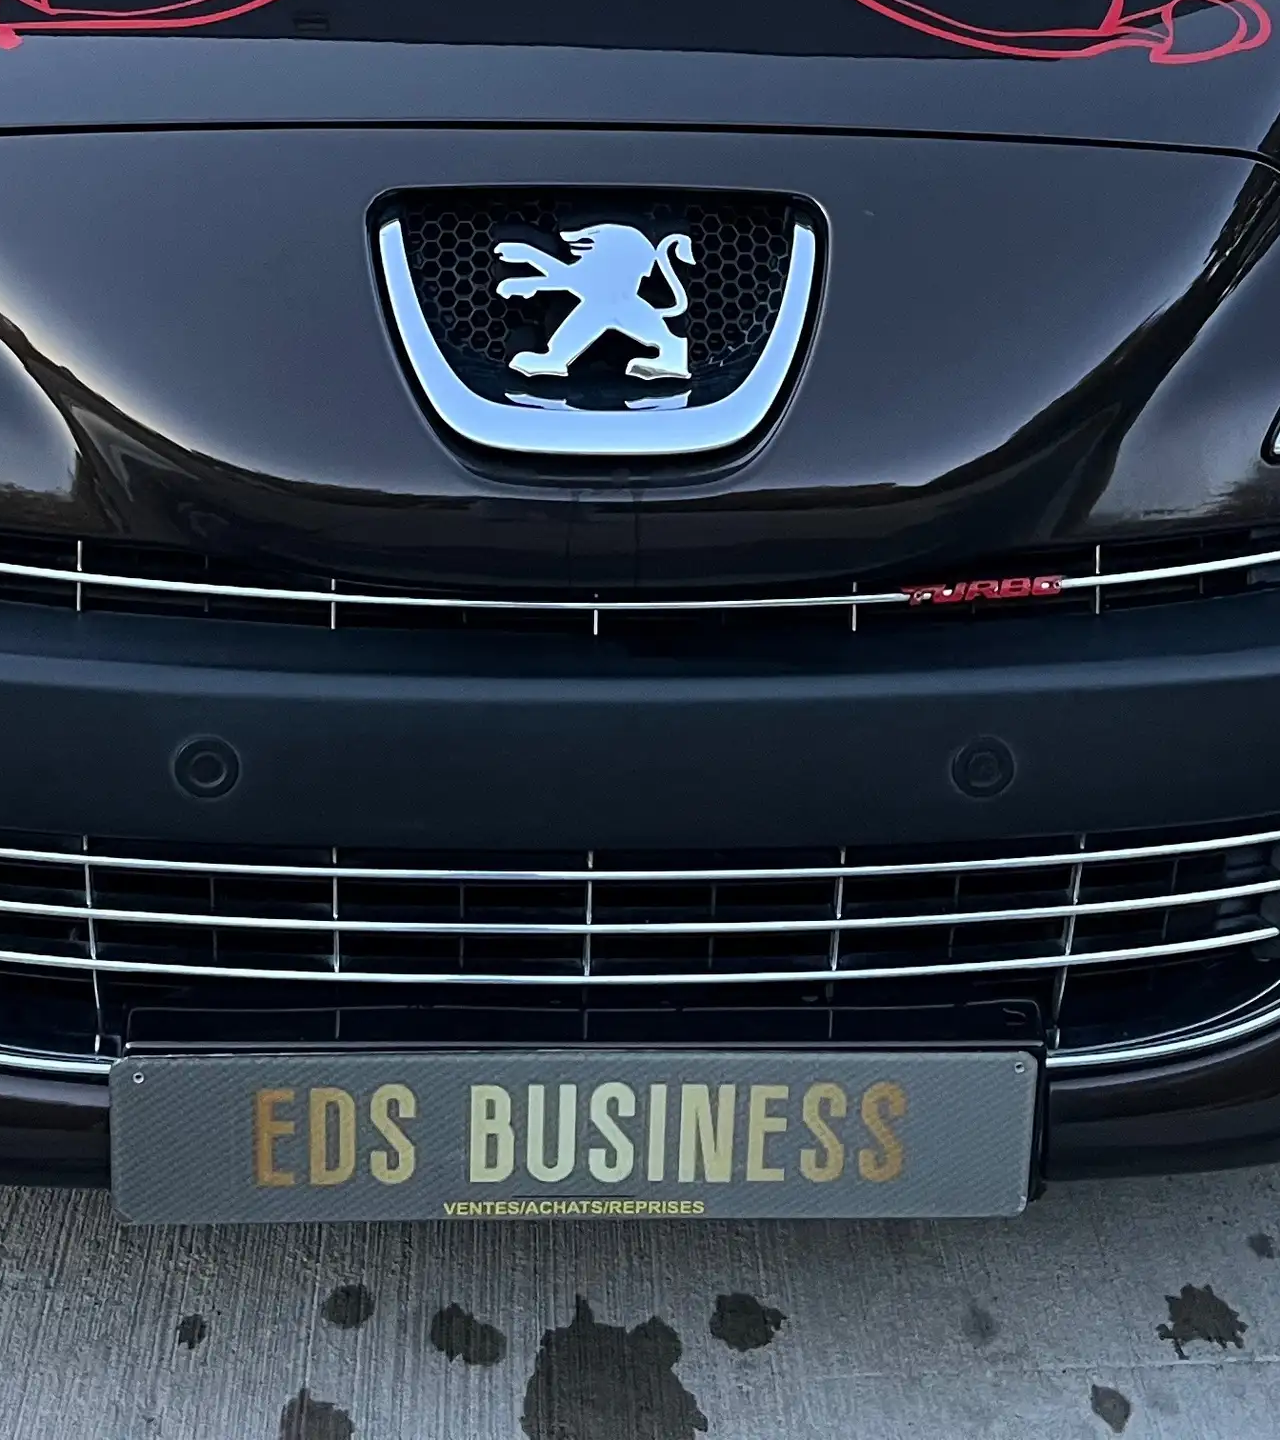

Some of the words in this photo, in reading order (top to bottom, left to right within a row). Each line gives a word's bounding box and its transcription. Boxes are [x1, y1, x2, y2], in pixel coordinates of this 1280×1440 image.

[901, 574, 1066, 606] TURBO
[251, 1082, 418, 1187] EDS
[469, 1080, 907, 1183] BUSINESS
[442, 1198, 706, 1218] VENTES/ACHATS/REPRISES
